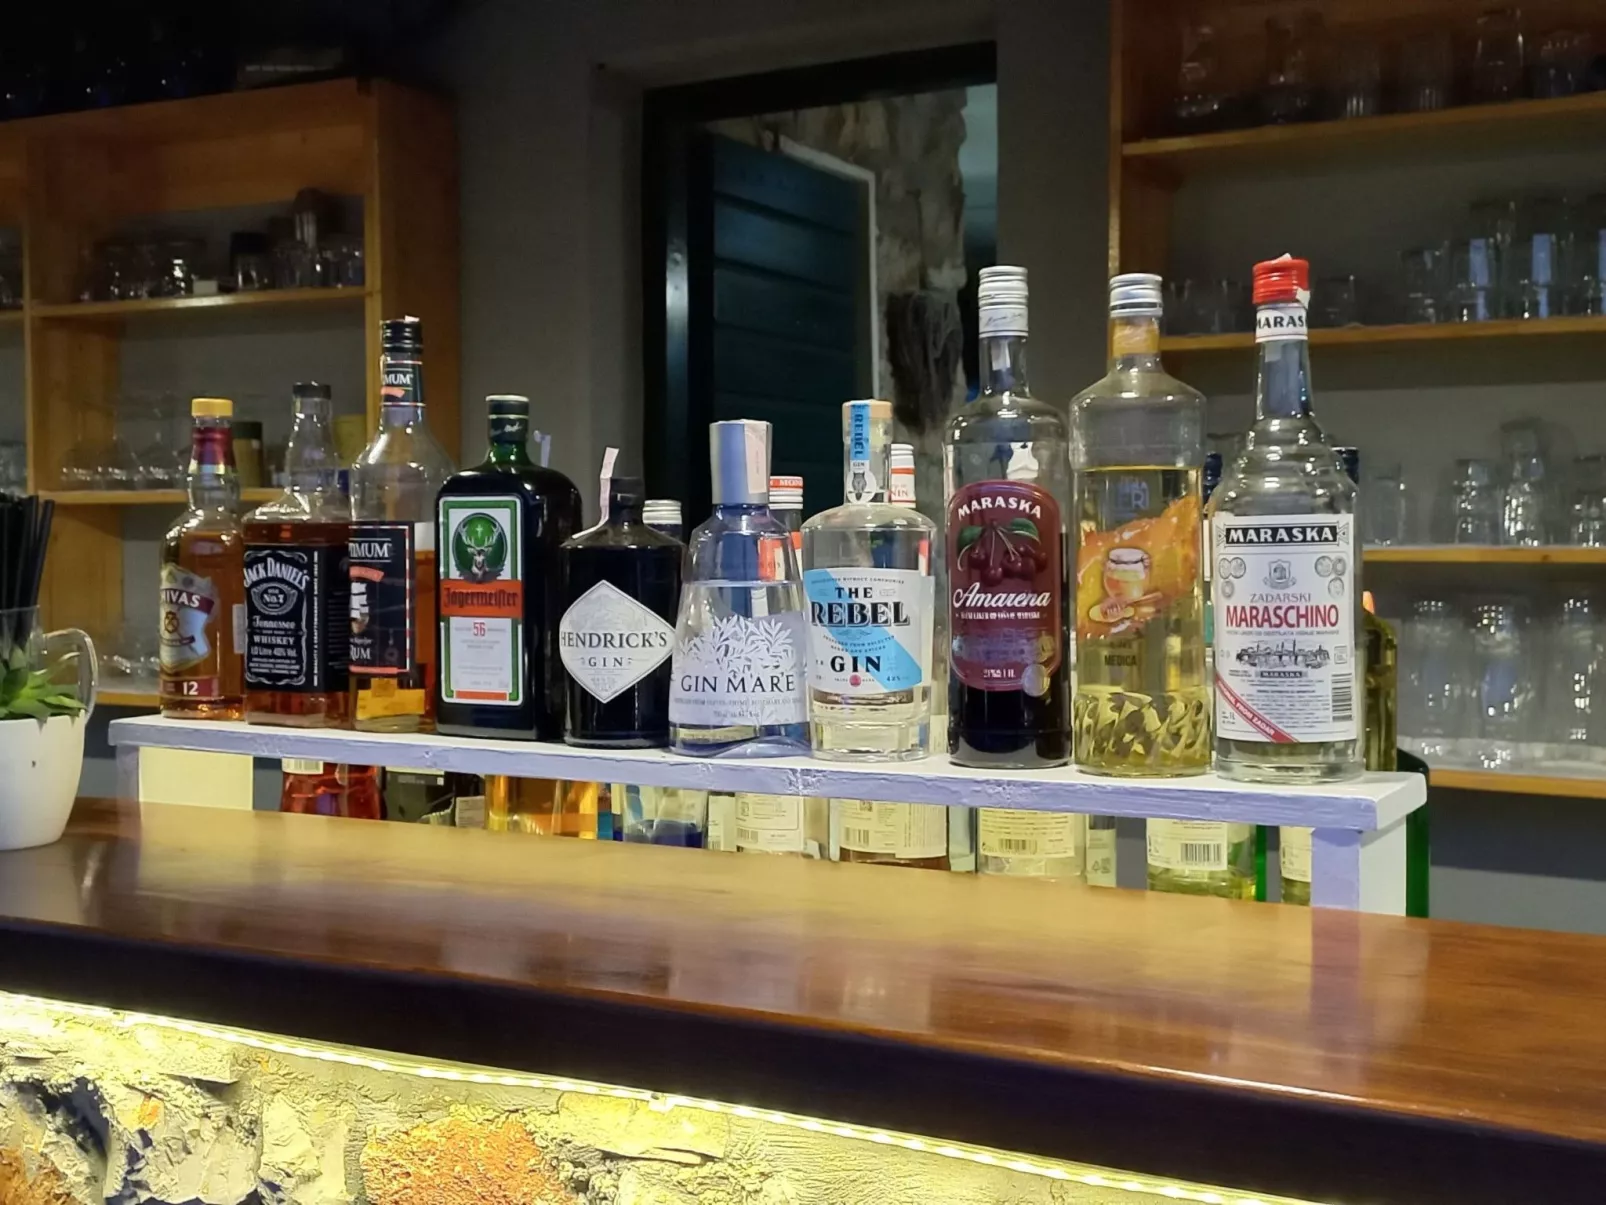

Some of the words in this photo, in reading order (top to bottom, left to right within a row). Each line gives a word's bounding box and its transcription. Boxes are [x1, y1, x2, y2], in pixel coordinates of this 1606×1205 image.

[1257, 315, 1305, 329] ARAS
[957, 495, 1041, 521] MARASKA
[1228, 526, 1334, 543] MARASKA
[243, 562, 267, 588] JACK
[267, 556, 310, 591] DANIEL'S
[834, 586, 873, 599] THE
[952, 581, 1052, 609] Amarena
[1249, 592, 1312, 603] ZADARSKI
[811, 601, 911, 627] REBEL
[1226, 604, 1339, 628] MARASCHINO
[473, 621, 486, 637] 56
[253, 635, 295, 645] WHISKEY
[561, 631, 668, 649] HENDRICK'S
[588, 656, 623, 668] GIN
[830, 655, 881, 673] GIN
[1104, 654, 1138, 667] MEDICA
[182, 681, 199, 696] 12
[680, 674, 718, 693] GIN
[726, 673, 796, 693] MARE
[1235, 702, 1254, 719] FROM
[1252, 716, 1276, 736] ZADAR
